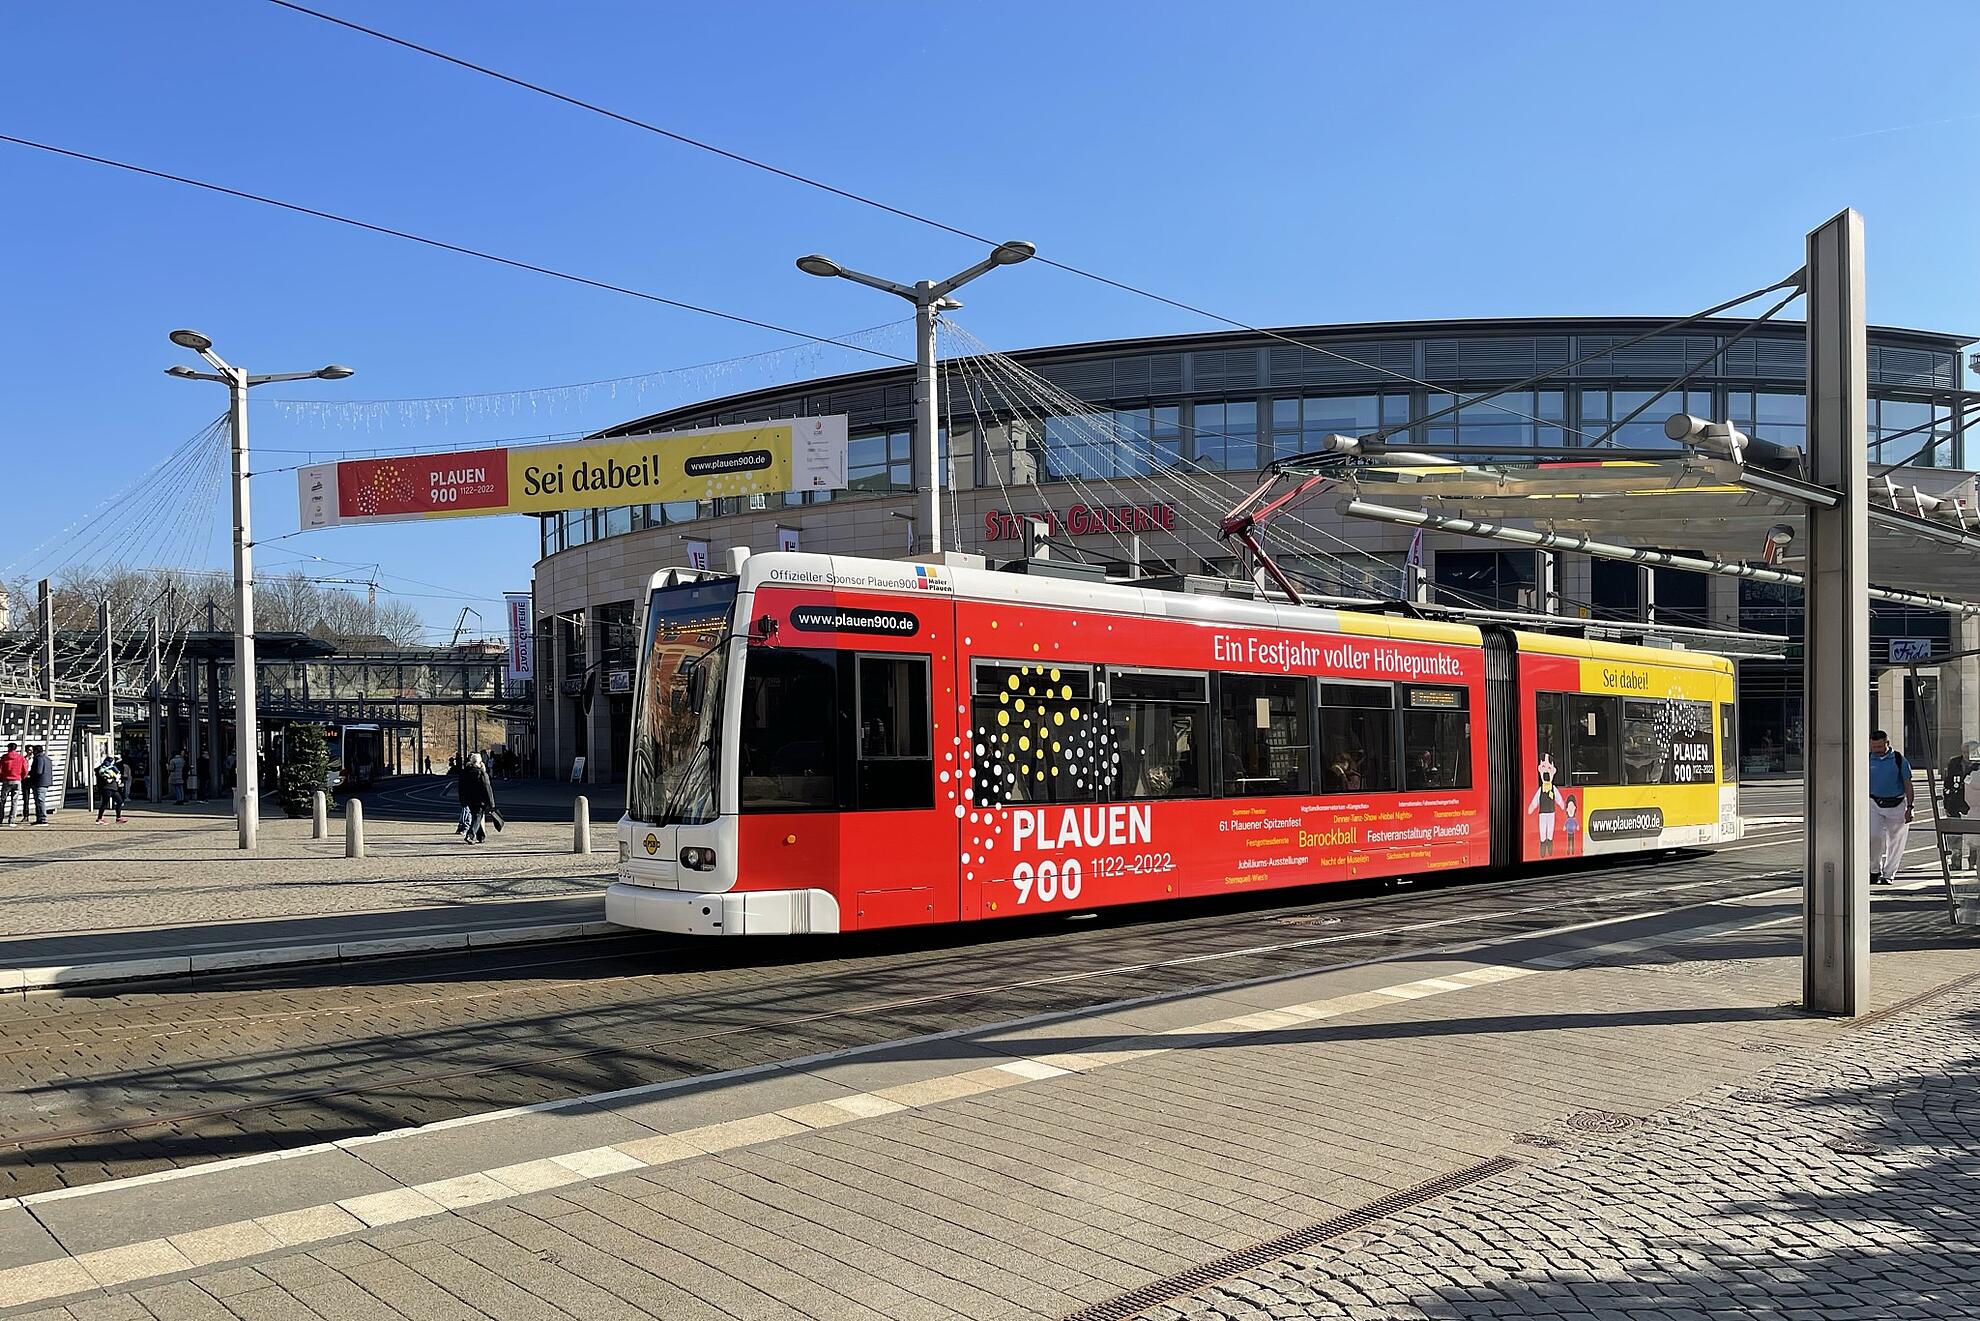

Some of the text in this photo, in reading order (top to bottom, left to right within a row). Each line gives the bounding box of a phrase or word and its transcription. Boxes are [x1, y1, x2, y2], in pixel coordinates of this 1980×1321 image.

[691, 455, 766, 471] www.plauen900.de
[430, 467, 486, 487] PLAUEN
[524, 454, 660, 496] Sei dabei!
[430, 487, 457, 504] 900
[984, 503, 1176, 541] STAT-GALERIE
[770, 569, 918, 589] Offizieller Sponsor Plauen900
[928, 584, 952, 592] Plauen
[798, 613, 914, 630] www.plauen900.de
[1213, 635, 1464, 679] Ein Festjahr voller Höhepunkte.
[1603, 668, 1649, 690] Sei dabei!
[1673, 743, 1709, 761] PLAUEN
[1674, 764, 1692, 782] 900
[1013, 805, 1152, 852] PLAUEN
[1219, 817, 1302, 832] 61. Plauener Spitzenfest
[1367, 823, 1470, 843] Festveranstaltung Plauen900
[1592, 814, 1661, 833] www.plauen900.de
[1299, 826, 1357, 848] Barockball
[1238, 855, 1309, 870] Jubiläums-Ausstellungen
[1012, 858, 1083, 905] 900
